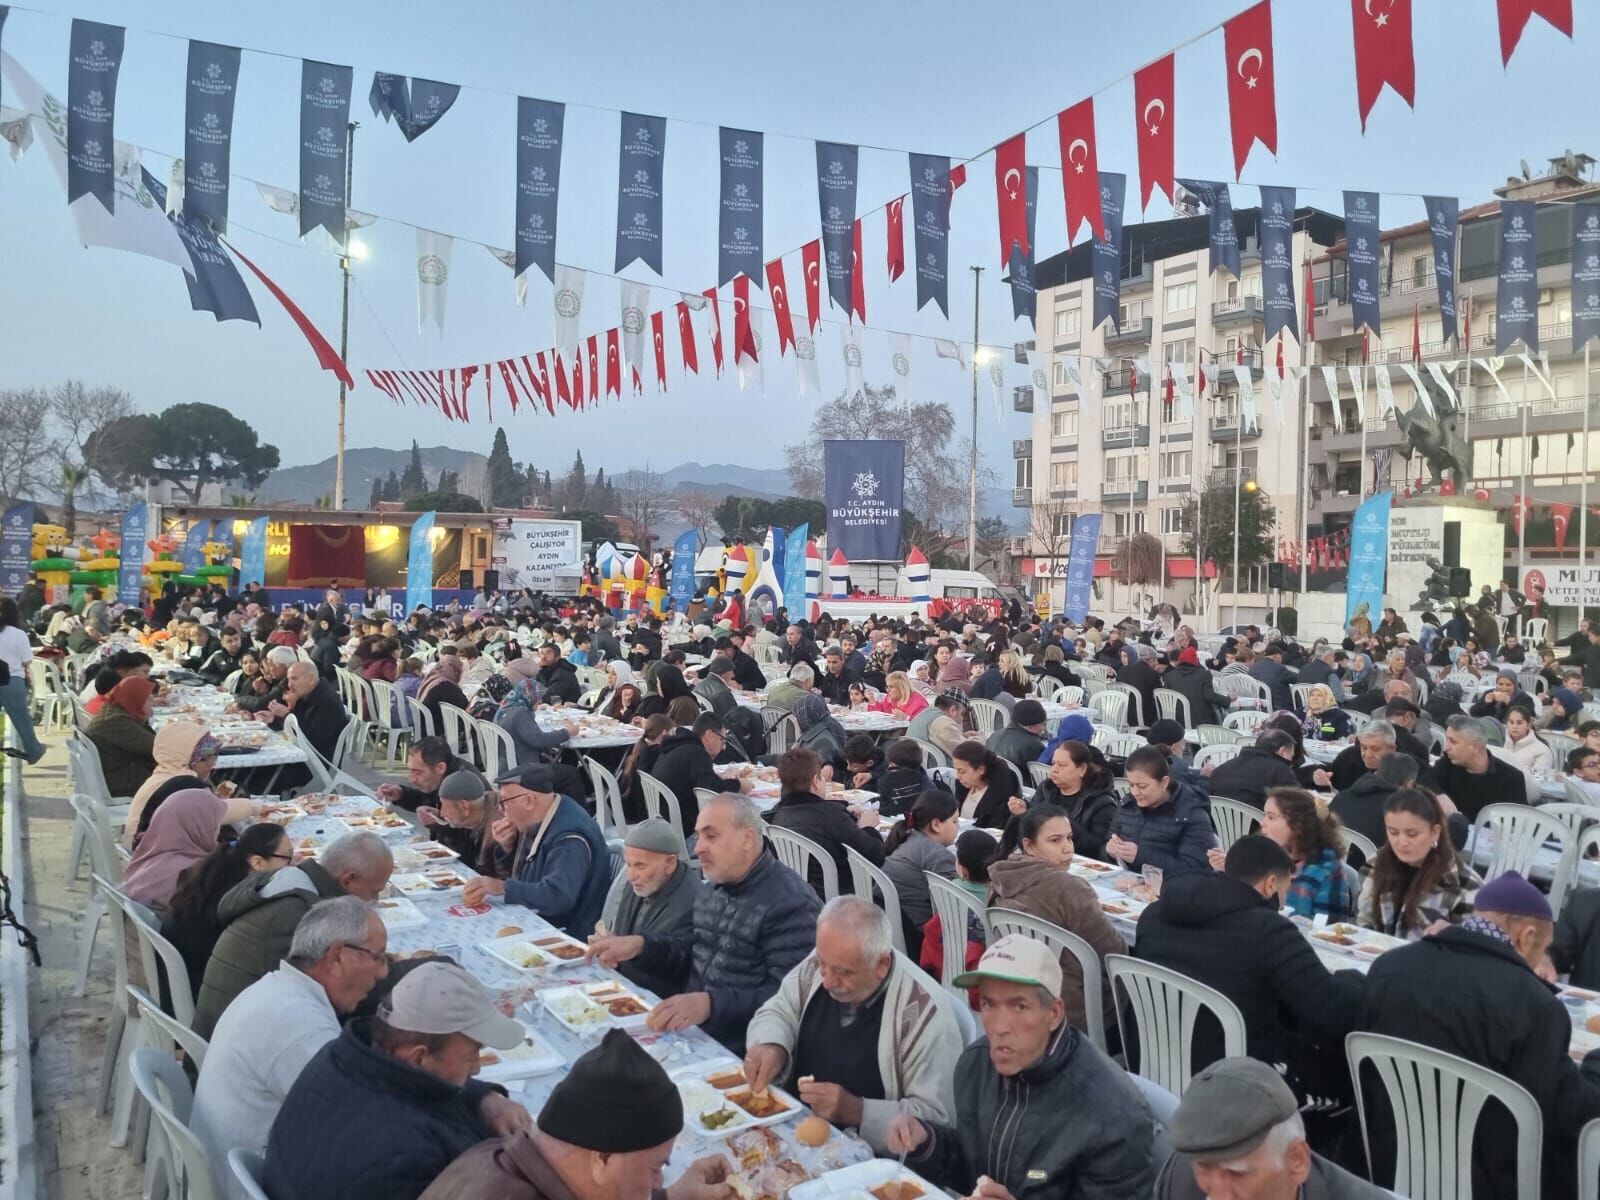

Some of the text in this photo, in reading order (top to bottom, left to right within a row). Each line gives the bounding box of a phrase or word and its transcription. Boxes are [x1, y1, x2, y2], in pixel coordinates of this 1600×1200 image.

[832, 507, 900, 518] BÜYÜKŞEHİR
[526, 528, 570, 539] BÜYÜKŞEHİR
[1391, 528, 1430, 538] MUTLU
[530, 540, 565, 550] ÇALIŞIYOR
[1390, 538, 1440, 550] TÜRKÜM
